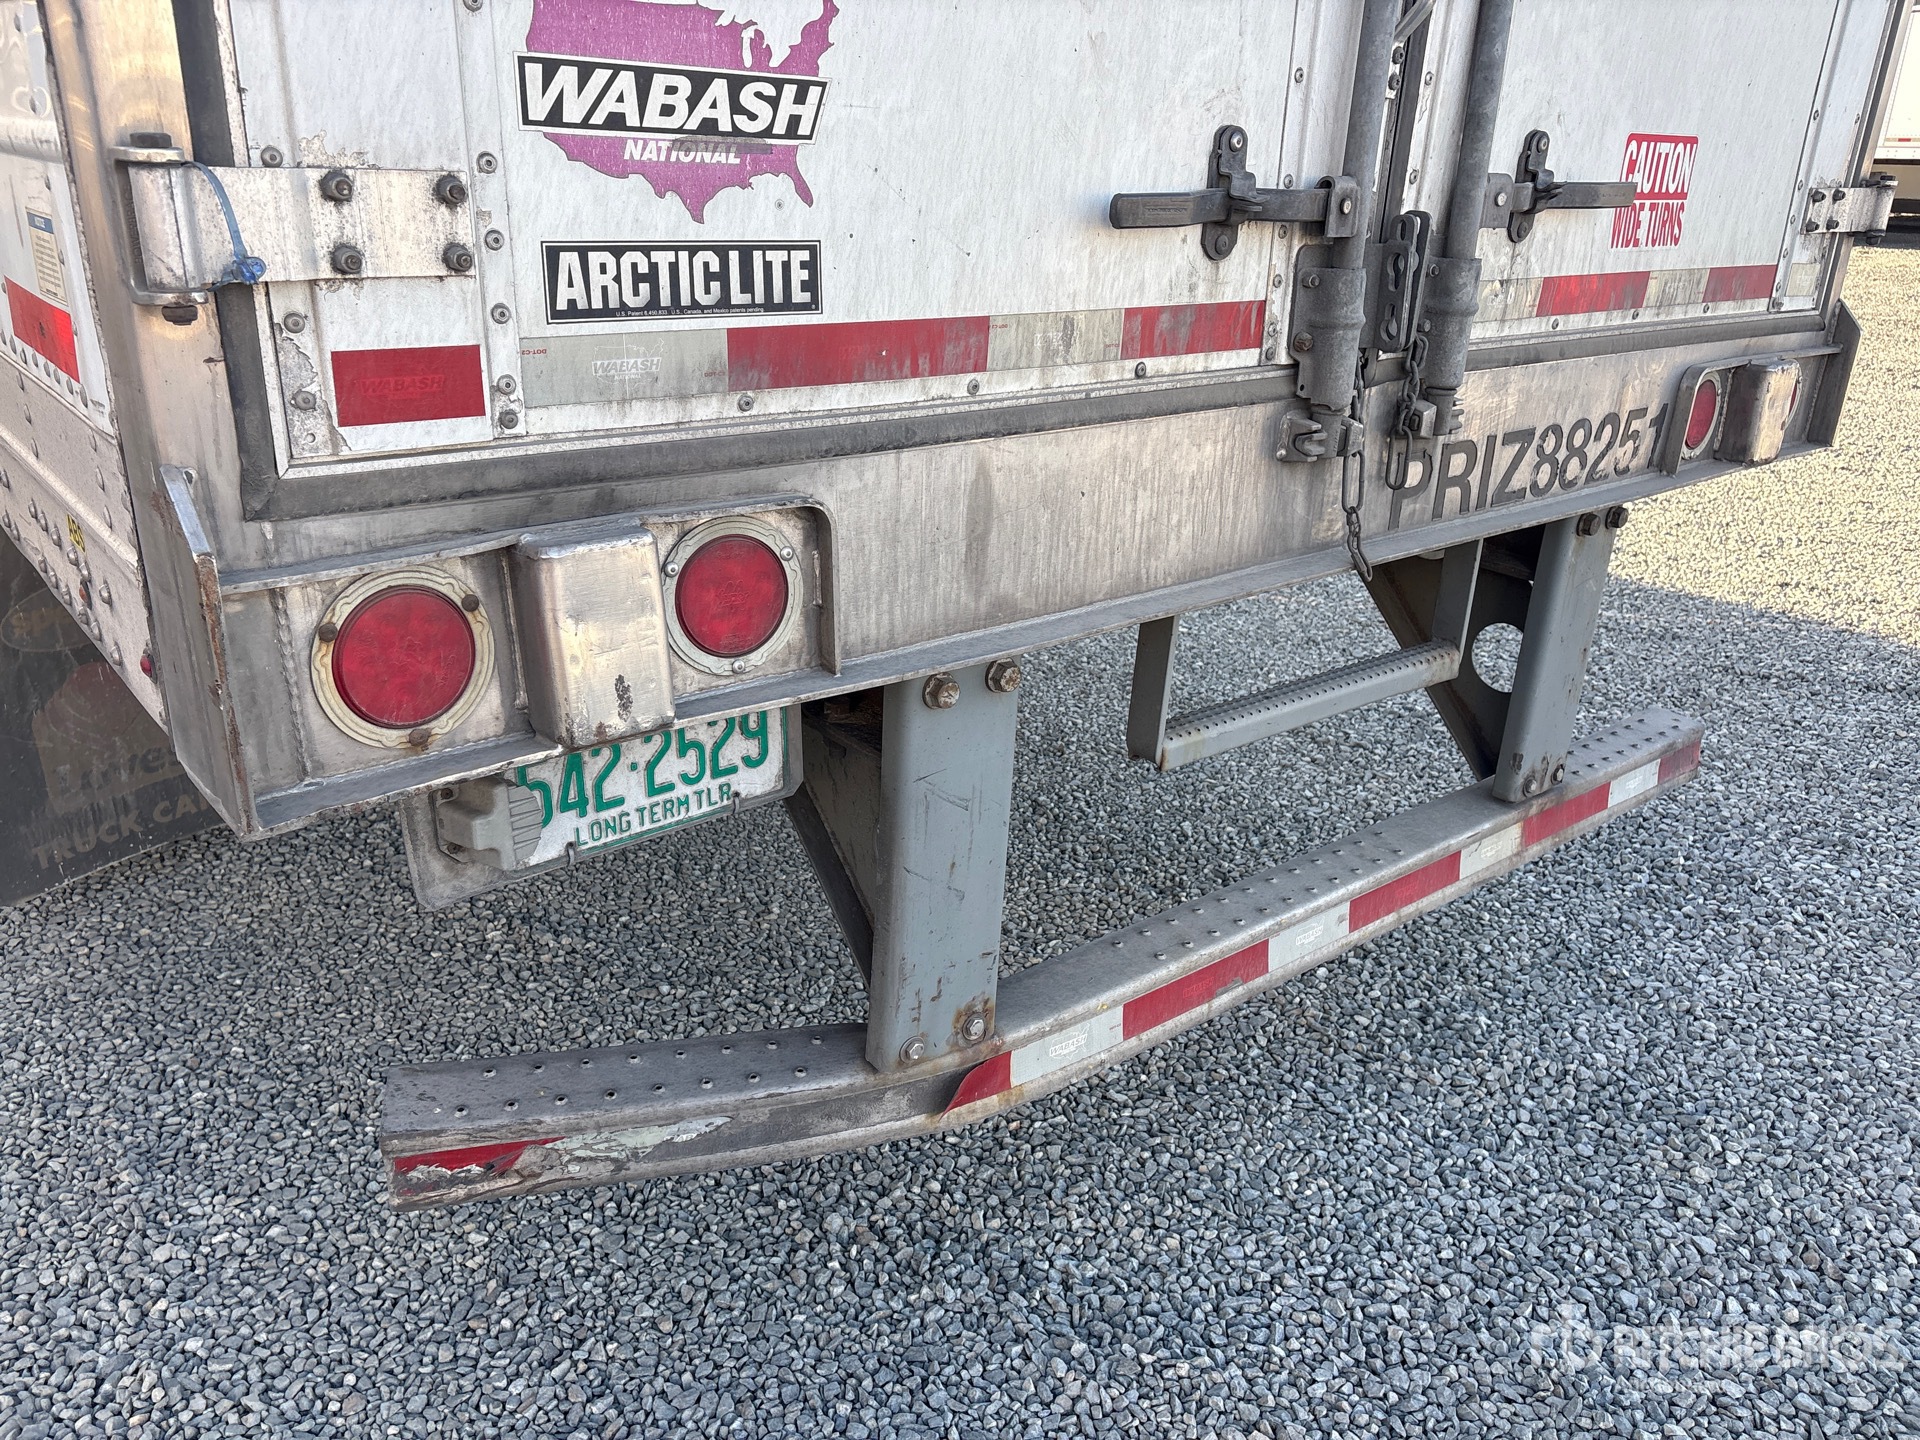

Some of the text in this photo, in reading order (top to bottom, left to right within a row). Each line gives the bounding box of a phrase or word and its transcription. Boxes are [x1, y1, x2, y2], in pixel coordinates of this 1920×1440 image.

[523, 62, 823, 136] WABASH
[623, 138, 741, 165] NATIONAL
[1619, 139, 1698, 194] CAUTION
[1611, 201, 1686, 249] WIDE TURNS
[593, 358, 661, 375] WABASH
[1387, 402, 1670, 532] PRIZ88251
[31, 809, 143, 870] TRUCK
[574, 782, 732, 847] LONG TERM TLR
[1050, 1035, 1088, 1056] WABASH
